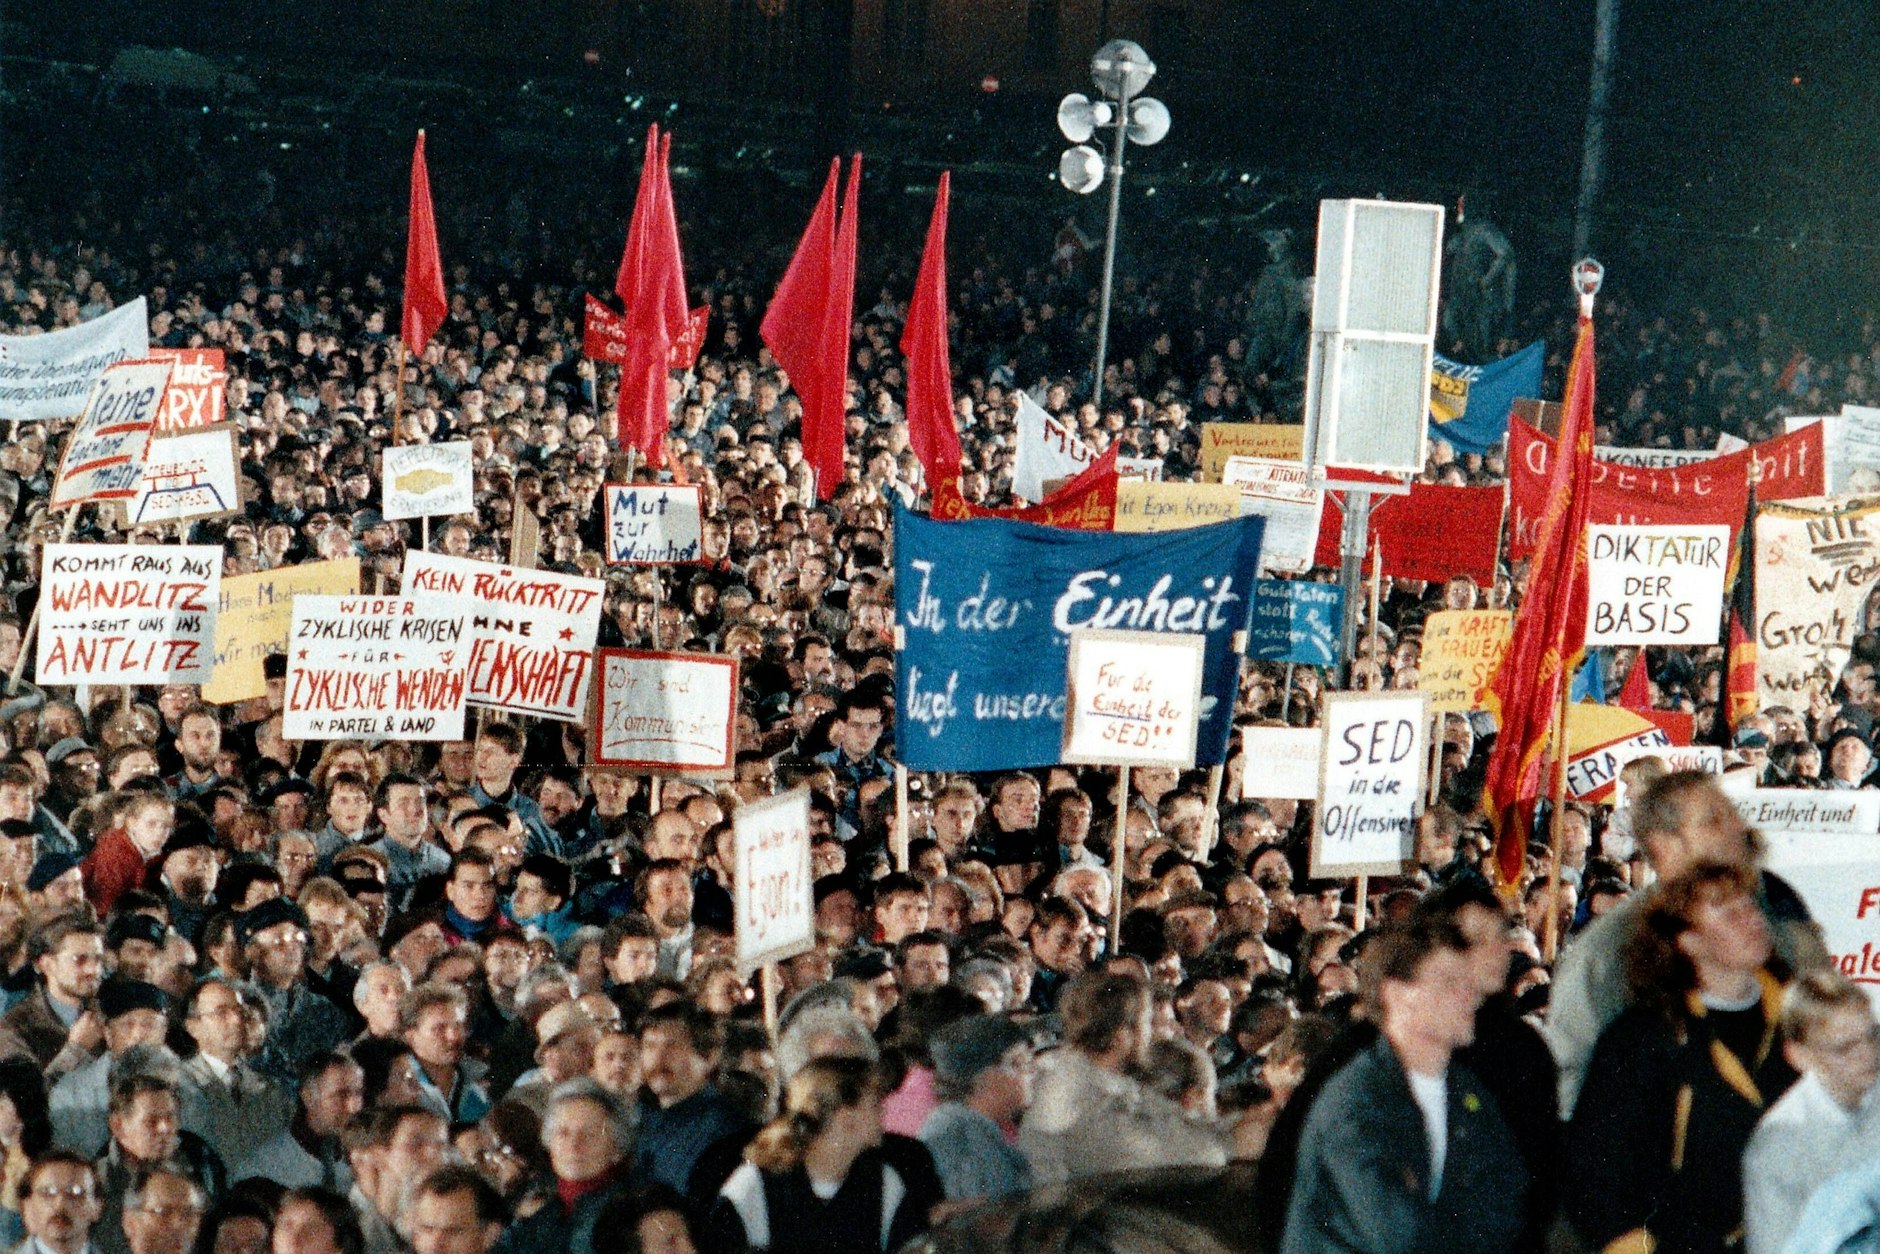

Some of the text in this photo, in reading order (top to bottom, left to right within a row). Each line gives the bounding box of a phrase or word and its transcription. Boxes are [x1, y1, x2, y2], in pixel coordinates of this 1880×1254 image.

[1043, 419, 1096, 463] MU
[613, 490, 669, 517] Mut
[1142, 493, 1179, 517] Egon
[614, 522, 648, 538] zur
[1593, 533, 1722, 569] DIKTATUR
[52, 554, 213, 579] KOMMT RAUS AUS
[51, 578, 209, 613] WANDLITZ
[413, 567, 599, 614] KEIN RÜCKTRITT
[1294, 582, 1339, 605] Taten
[1624, 575, 1672, 598] DER
[340, 601, 415, 616] WIDER
[956, 570, 1033, 632] der
[1053, 570, 1242, 634] Einheit
[90, 617, 202, 634] SEHT UNS INS
[297, 615, 464, 643] ZYKLISCHE KRISEN
[473, 615, 533, 637] HNE
[1459, 615, 1510, 638] KRAFT
[1594, 603, 1693, 635] BASIS
[43, 636, 203, 676] ANTLITZ
[351, 650, 389, 664] FÜR
[1441, 637, 1508, 659] FRAUEN
[467, 637, 592, 708] ENSCHAFT
[607, 664, 640, 691] Wir
[289, 667, 465, 713] ZYKLISCHE WENDEN
[604, 699, 722, 738] Kommunisten
[1092, 692, 1152, 719] Einheit
[1158, 700, 1182, 720] der
[309, 717, 436, 734] IN PARTEI & LAND
[1338, 718, 1415, 767] SED
[1348, 770, 1402, 795] in die
[1323, 800, 1417, 842] Offensive!
[1757, 800, 1819, 828] Einheit
[1820, 803, 1858, 823] und
